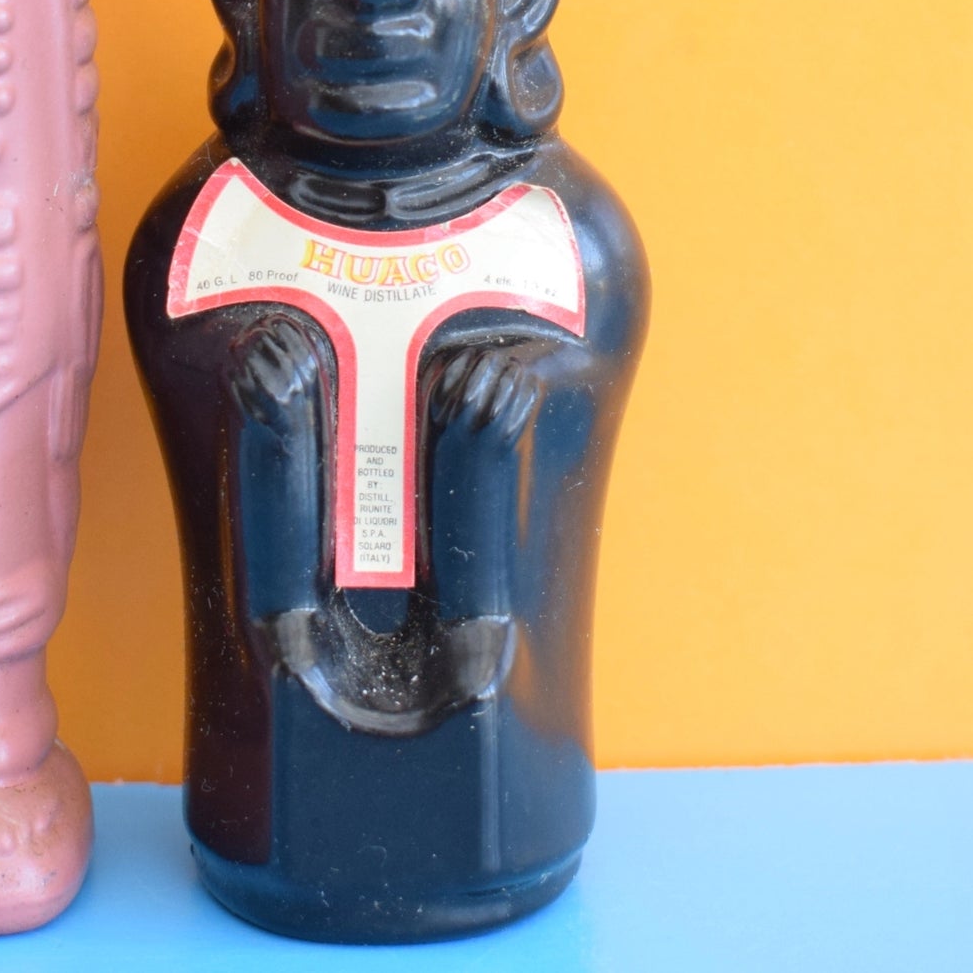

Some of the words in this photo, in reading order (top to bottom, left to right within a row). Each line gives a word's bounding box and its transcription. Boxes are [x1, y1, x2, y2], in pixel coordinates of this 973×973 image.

[300, 239, 471, 287] HUACO
[196, 279, 210, 291] 40
[248, 270, 264, 282] 80
[267, 269, 299, 283] Proof
[327, 281, 359, 300] WINE
[364, 282, 437, 303] DISTILLATE
[354, 444, 397, 455] PRODUCED
[367, 457, 384, 465] AND
[358, 468, 395, 478] BOTTLED
[360, 505, 393, 514] RIUNITE
[354, 516, 361, 525] DI
[365, 517, 397, 526] LIQUORI
[360, 554, 391, 564] (ITALY)
